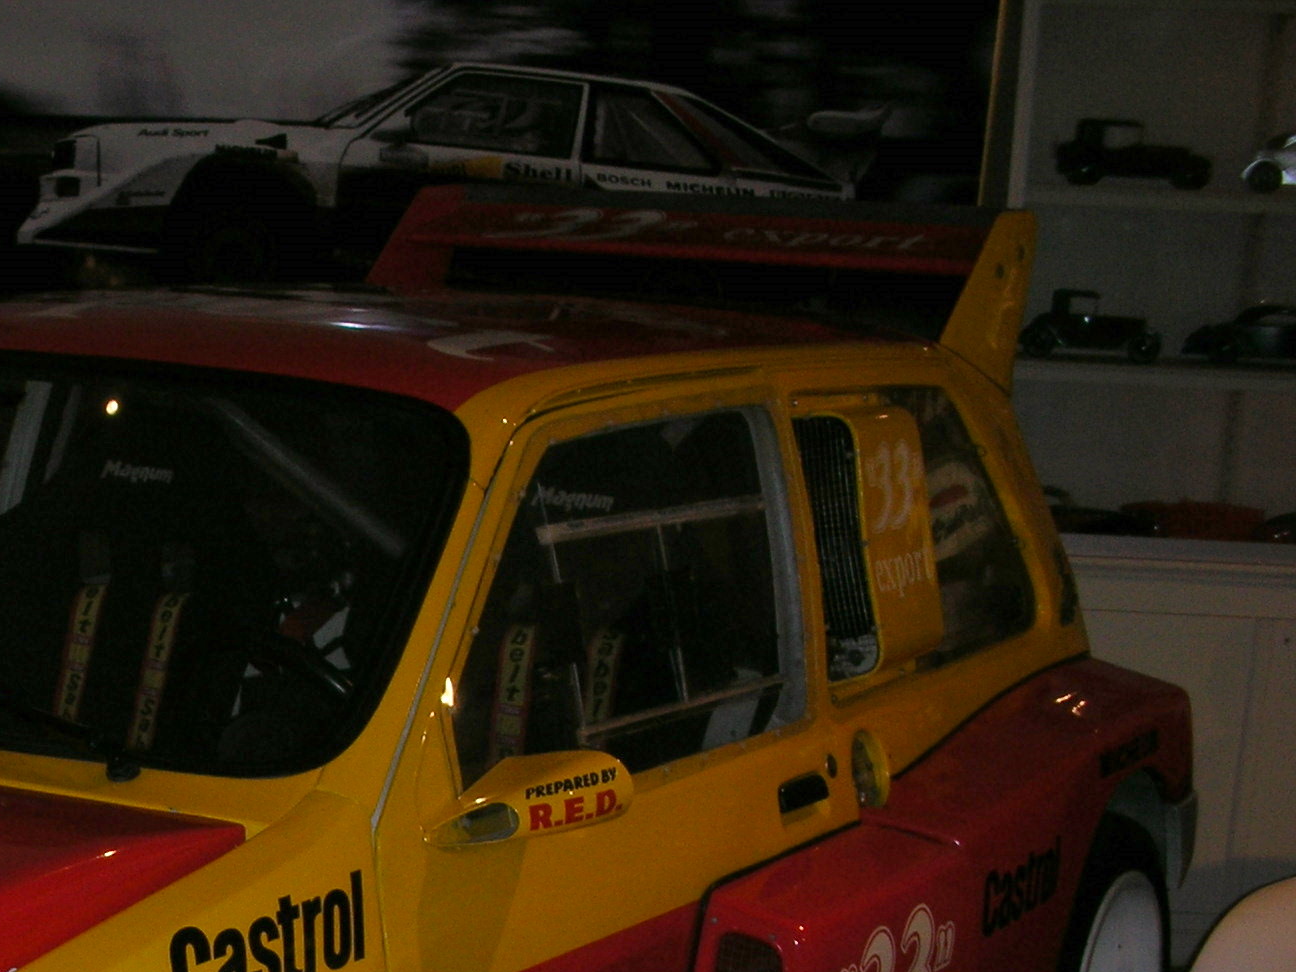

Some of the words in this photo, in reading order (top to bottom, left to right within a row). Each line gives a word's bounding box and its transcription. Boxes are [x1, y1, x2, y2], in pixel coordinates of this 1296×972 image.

[505, 161, 572, 182] Shell
[596, 173, 652, 189] BOSCH
[666, 182, 755, 199] MICHELIN
[875, 546, 936, 598] export
[524, 771, 600, 800] PREPARED
[600, 767, 618, 786] BY
[983, 835, 1062, 937] Castrol
